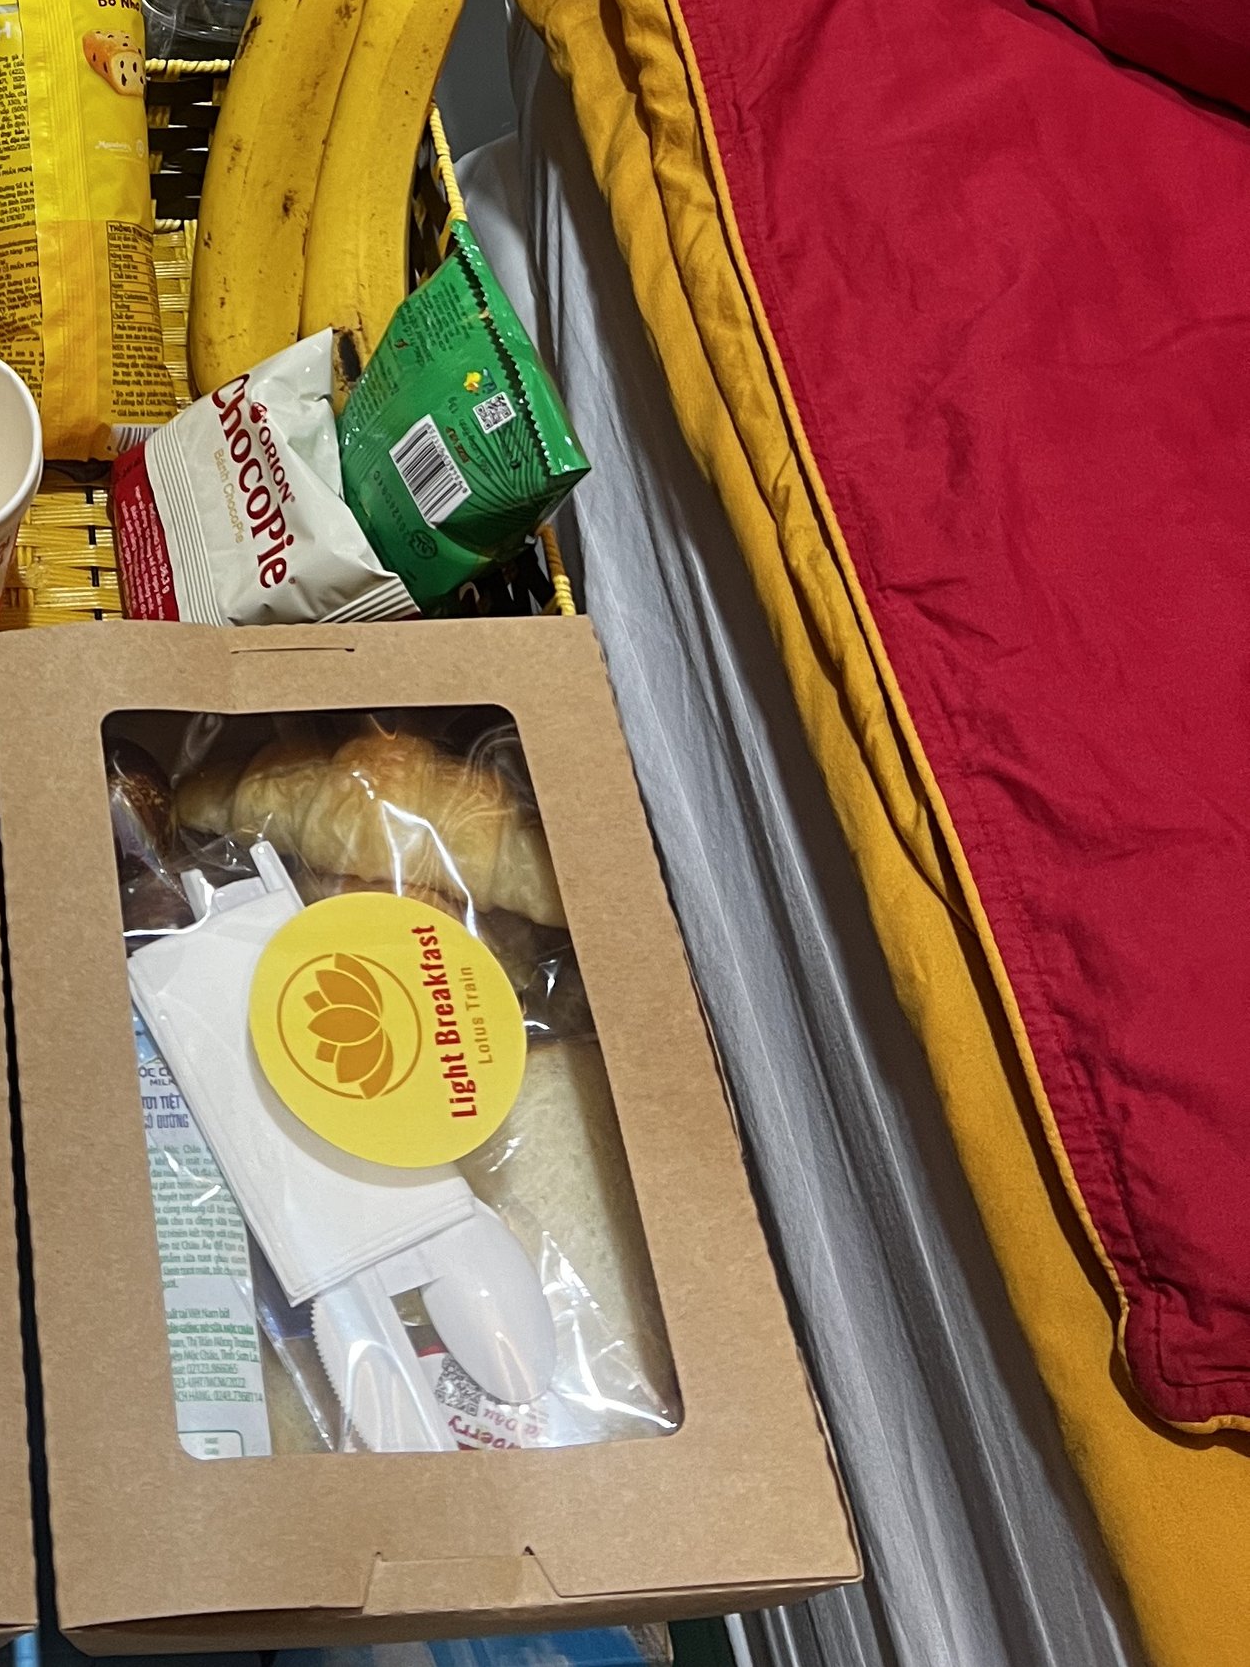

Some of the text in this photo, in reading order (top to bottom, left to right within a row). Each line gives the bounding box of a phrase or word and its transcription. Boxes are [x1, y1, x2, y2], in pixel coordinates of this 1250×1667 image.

[213, 448, 244, 544] Bánh ChocoPie
[258, 425, 293, 505] ORION
[410, 924, 478, 1119] Light Breakfast
[459, 966, 493, 1065] Lotus Train
[160, 1094, 182, 1110] TIỆT
